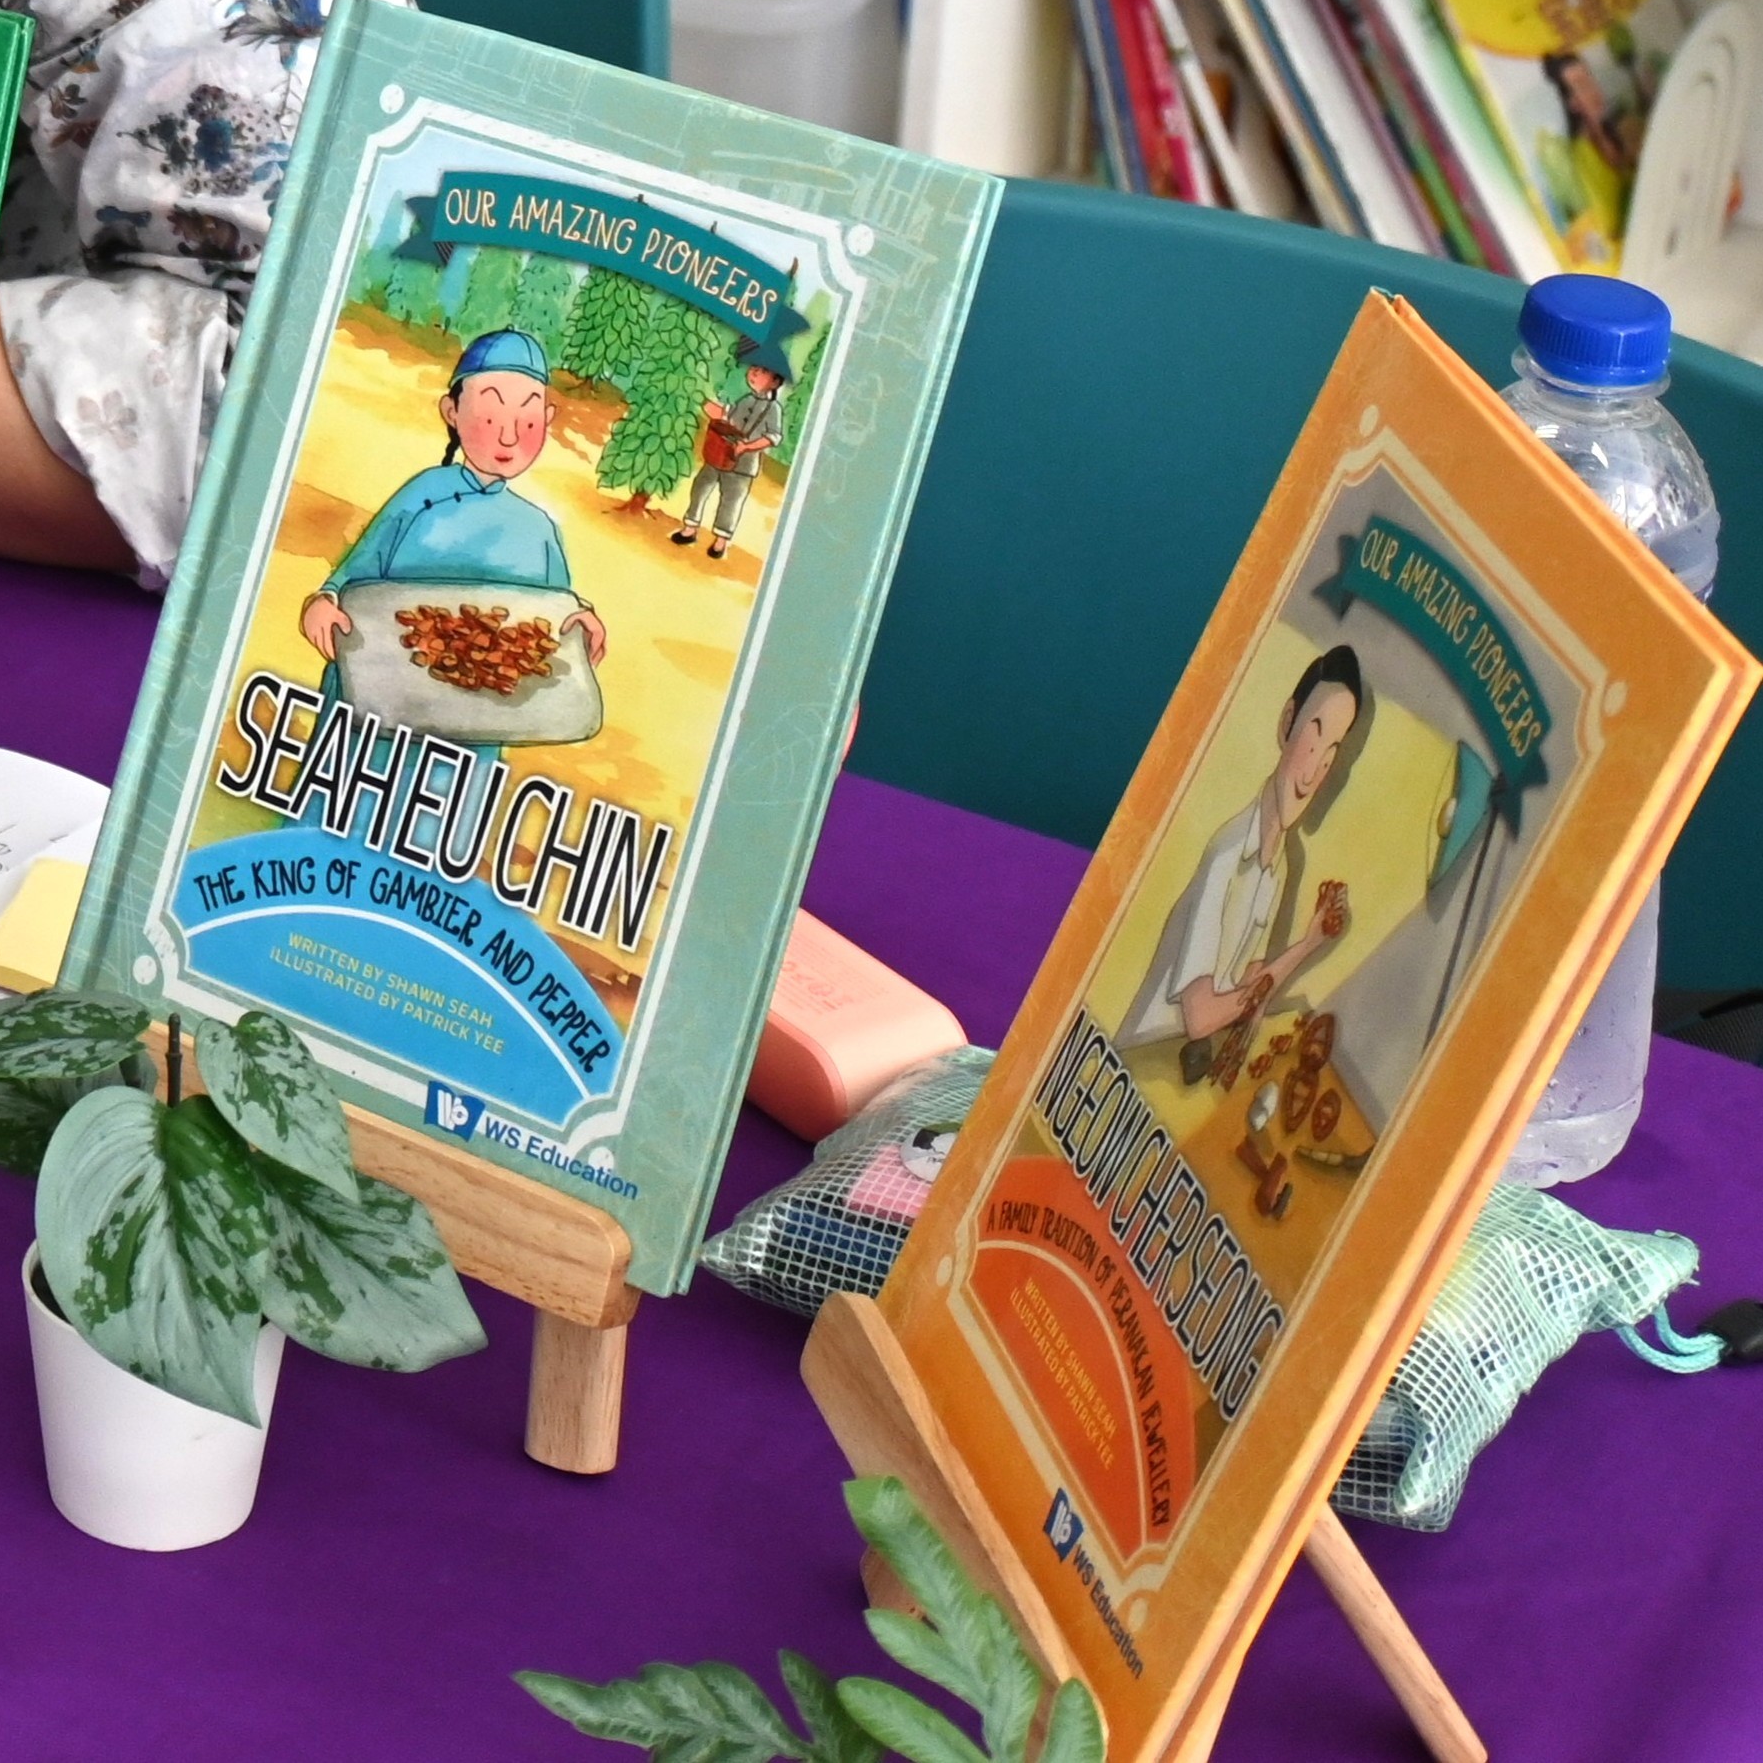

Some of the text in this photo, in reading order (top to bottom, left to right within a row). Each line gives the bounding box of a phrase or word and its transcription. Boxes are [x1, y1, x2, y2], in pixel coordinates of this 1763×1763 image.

[445, 188, 778, 324] OUR AMAZING PIONEERS
[1360, 528, 1541, 757] OUR AMAZING PIONEERS
[216, 670, 674, 953] SEAH EU CHIN
[193, 856, 611, 1074] THE KING OF GAMBIER AND PEPPER
[270, 946, 506, 1055] ILLUSTRATED BY PATRICK YEE
[288, 932, 493, 1030] WRITTEN BY SHAWN SEAH
[484, 1116, 639, 1200] WS Education
[1034, 1007, 1286, 1423] NGEOW CHER SEONG
[986, 1201, 1172, 1527] A FAMILY TRADITION OF PERANAKAN JEWELLERY
[1010, 1287, 1115, 1470] ILLUSTRATED BY PATRICK YEE
[1025, 1277, 1116, 1438] WRITTEN BY SHAWN SEAH
[1071, 1544, 1146, 1680] WS Education
